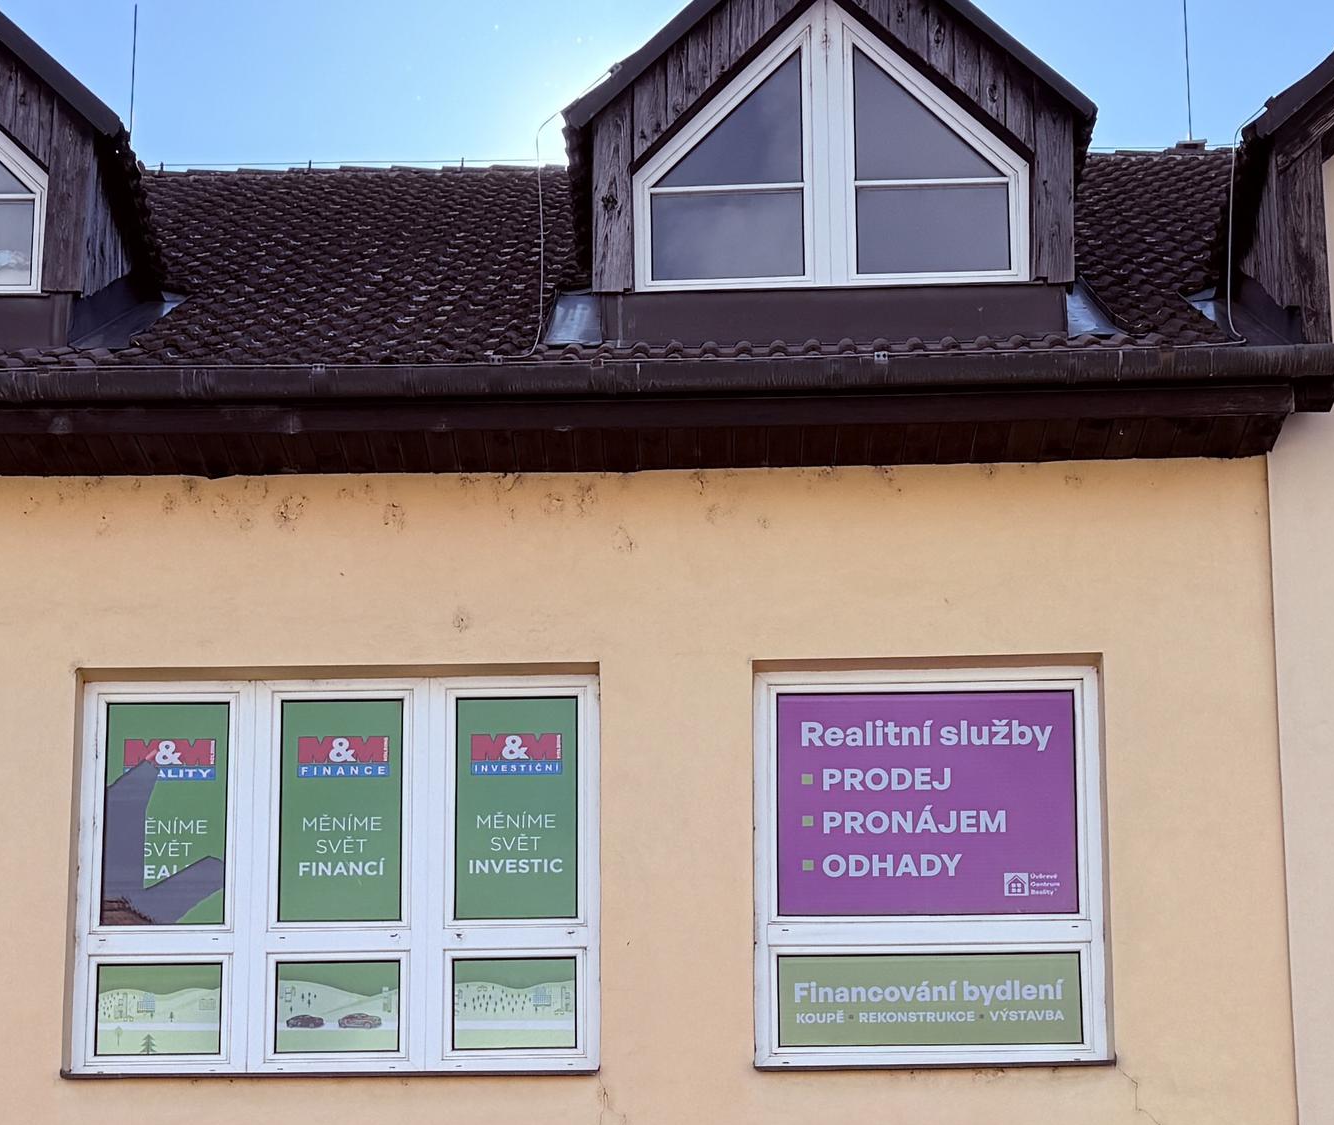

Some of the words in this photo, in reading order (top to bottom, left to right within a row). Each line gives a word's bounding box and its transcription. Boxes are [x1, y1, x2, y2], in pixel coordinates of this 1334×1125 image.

[801, 719, 933, 747] Realitní
[939, 719, 1052, 751] služby
[297, 736, 390, 764] M&M
[470, 733, 563, 761] M&M
[301, 766, 386, 775] FINANCE
[474, 763, 559, 773] INVESTIČNÍ
[822, 767, 951, 791] PRODEJ
[145, 817, 208, 835] ĚNÍME
[302, 814, 382, 832] MĚNÍME
[476, 811, 556, 829] MĚNÍME
[822, 805, 1007, 834] PRONÁJEM
[316, 836, 367, 854] SVĚT
[490, 833, 541, 851] SVĚT
[298, 858, 385, 877] FINANCÍ
[469, 858, 563, 874] INVESTIC
[822, 854, 963, 877] ODHADY
[794, 980, 957, 1003] Financování
[963, 979, 1064, 1006] bydlení
[796, 1009, 844, 1024] KOUPĚ
[859, 1011, 975, 1023] REKONSTRUKCE
[989, 1008, 1065, 1021] VÝSTAVBA
